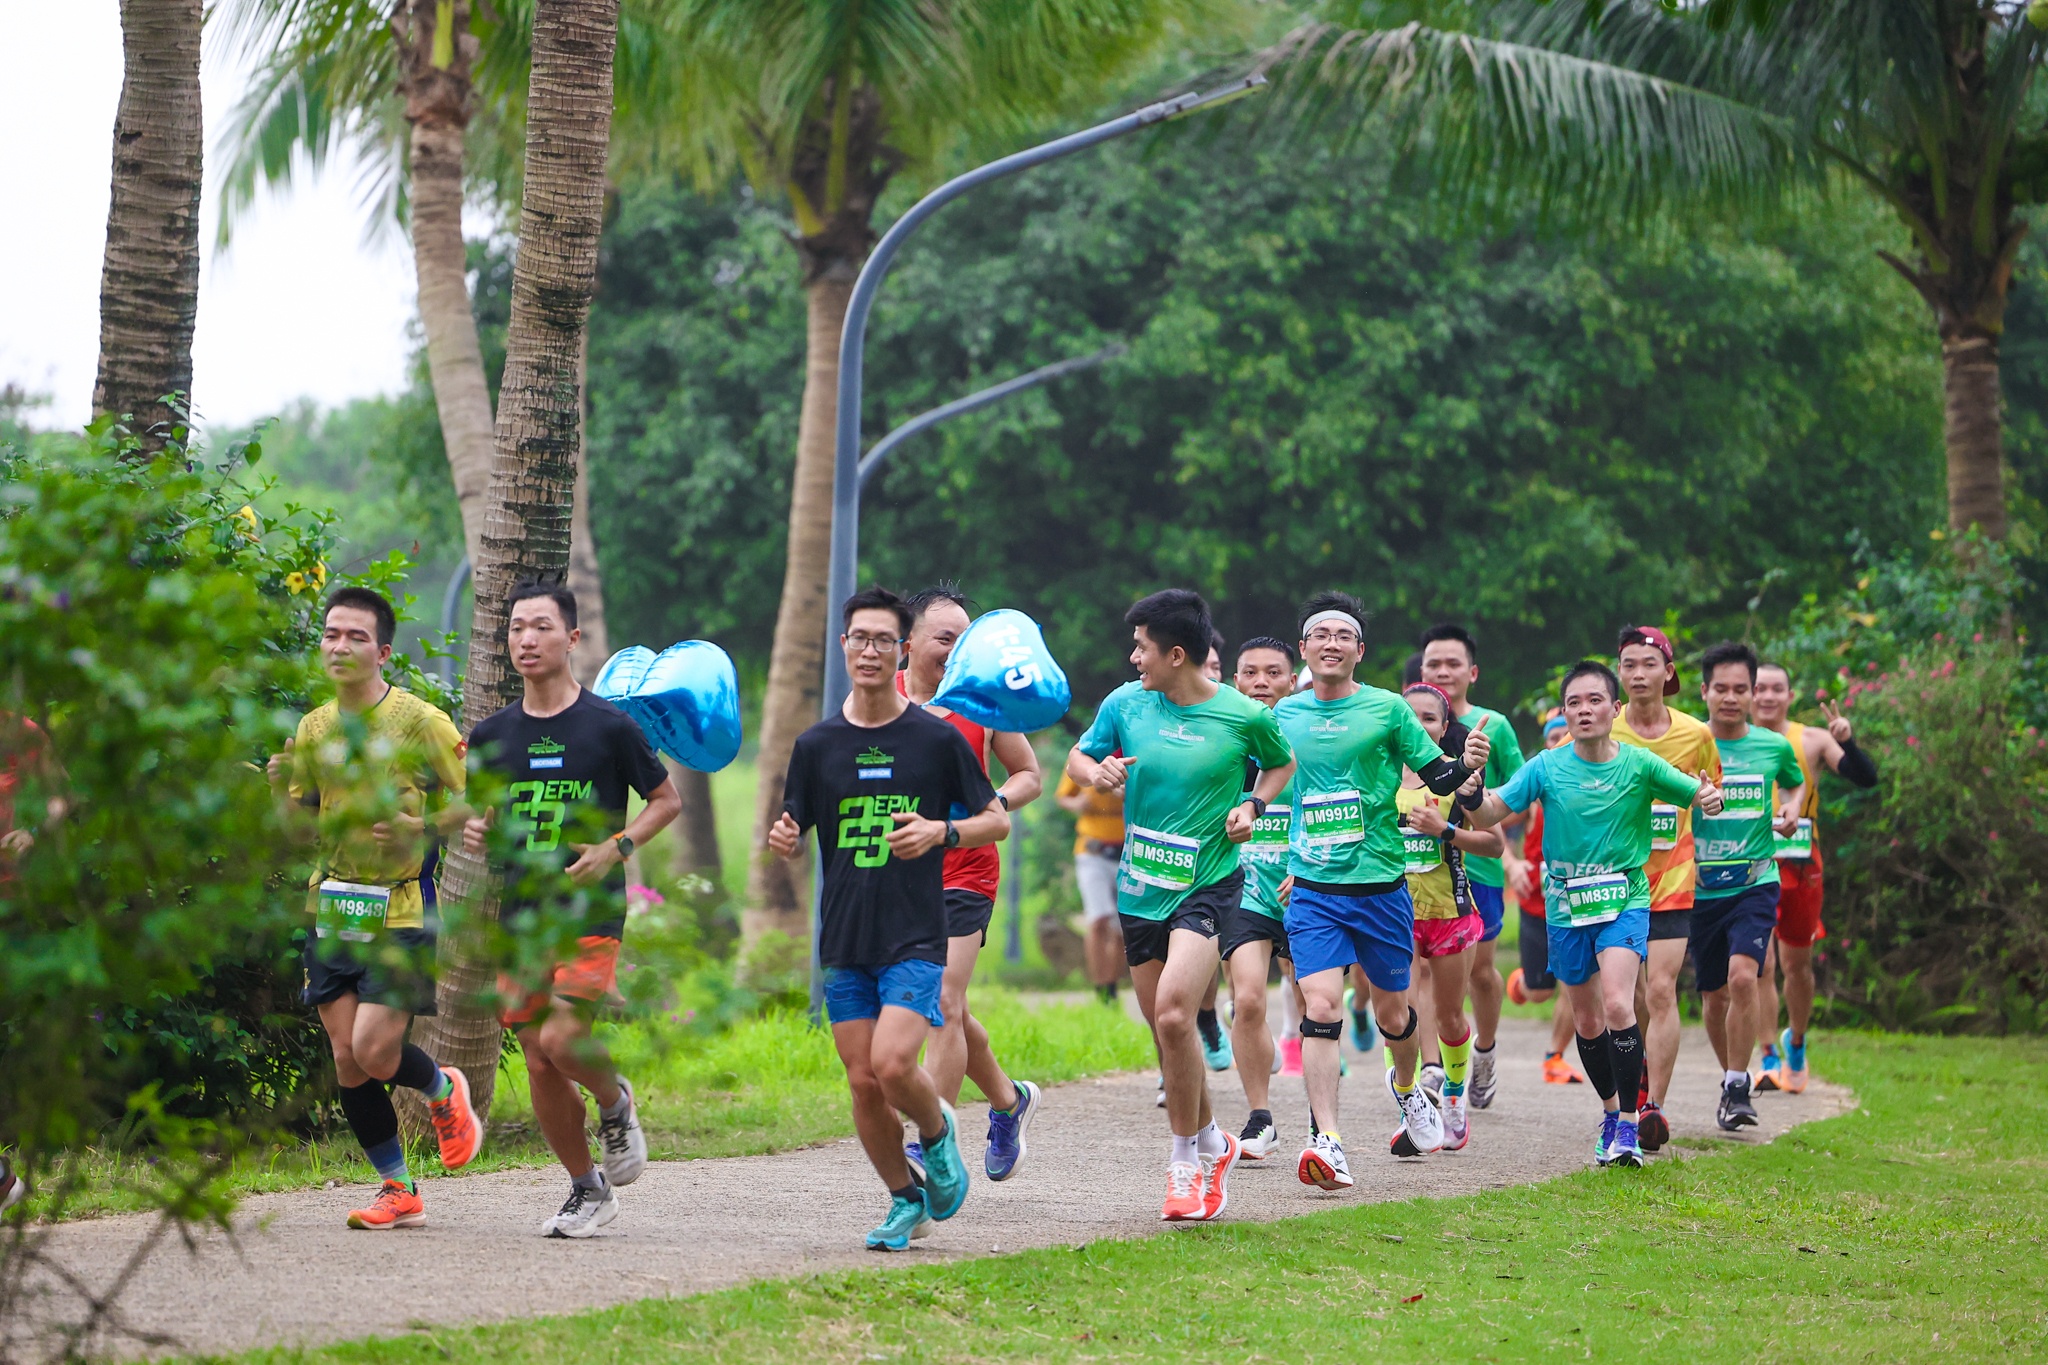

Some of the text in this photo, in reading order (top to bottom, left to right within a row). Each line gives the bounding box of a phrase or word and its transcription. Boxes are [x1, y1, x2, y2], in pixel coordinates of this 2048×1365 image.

[984, 624, 1043, 690] 1:45
[544, 780, 592, 799] EPM
[874, 794, 920, 814] EPM
[1314, 805, 1359, 824] M9912
[837, 795, 895, 867] 23
[1651, 818, 1675, 831] 257
[1144, 844, 1194, 869] M9358
[1708, 840, 1748, 855] EPM
[1575, 862, 1614, 877] EPM
[1581, 886, 1627, 904] M8373
